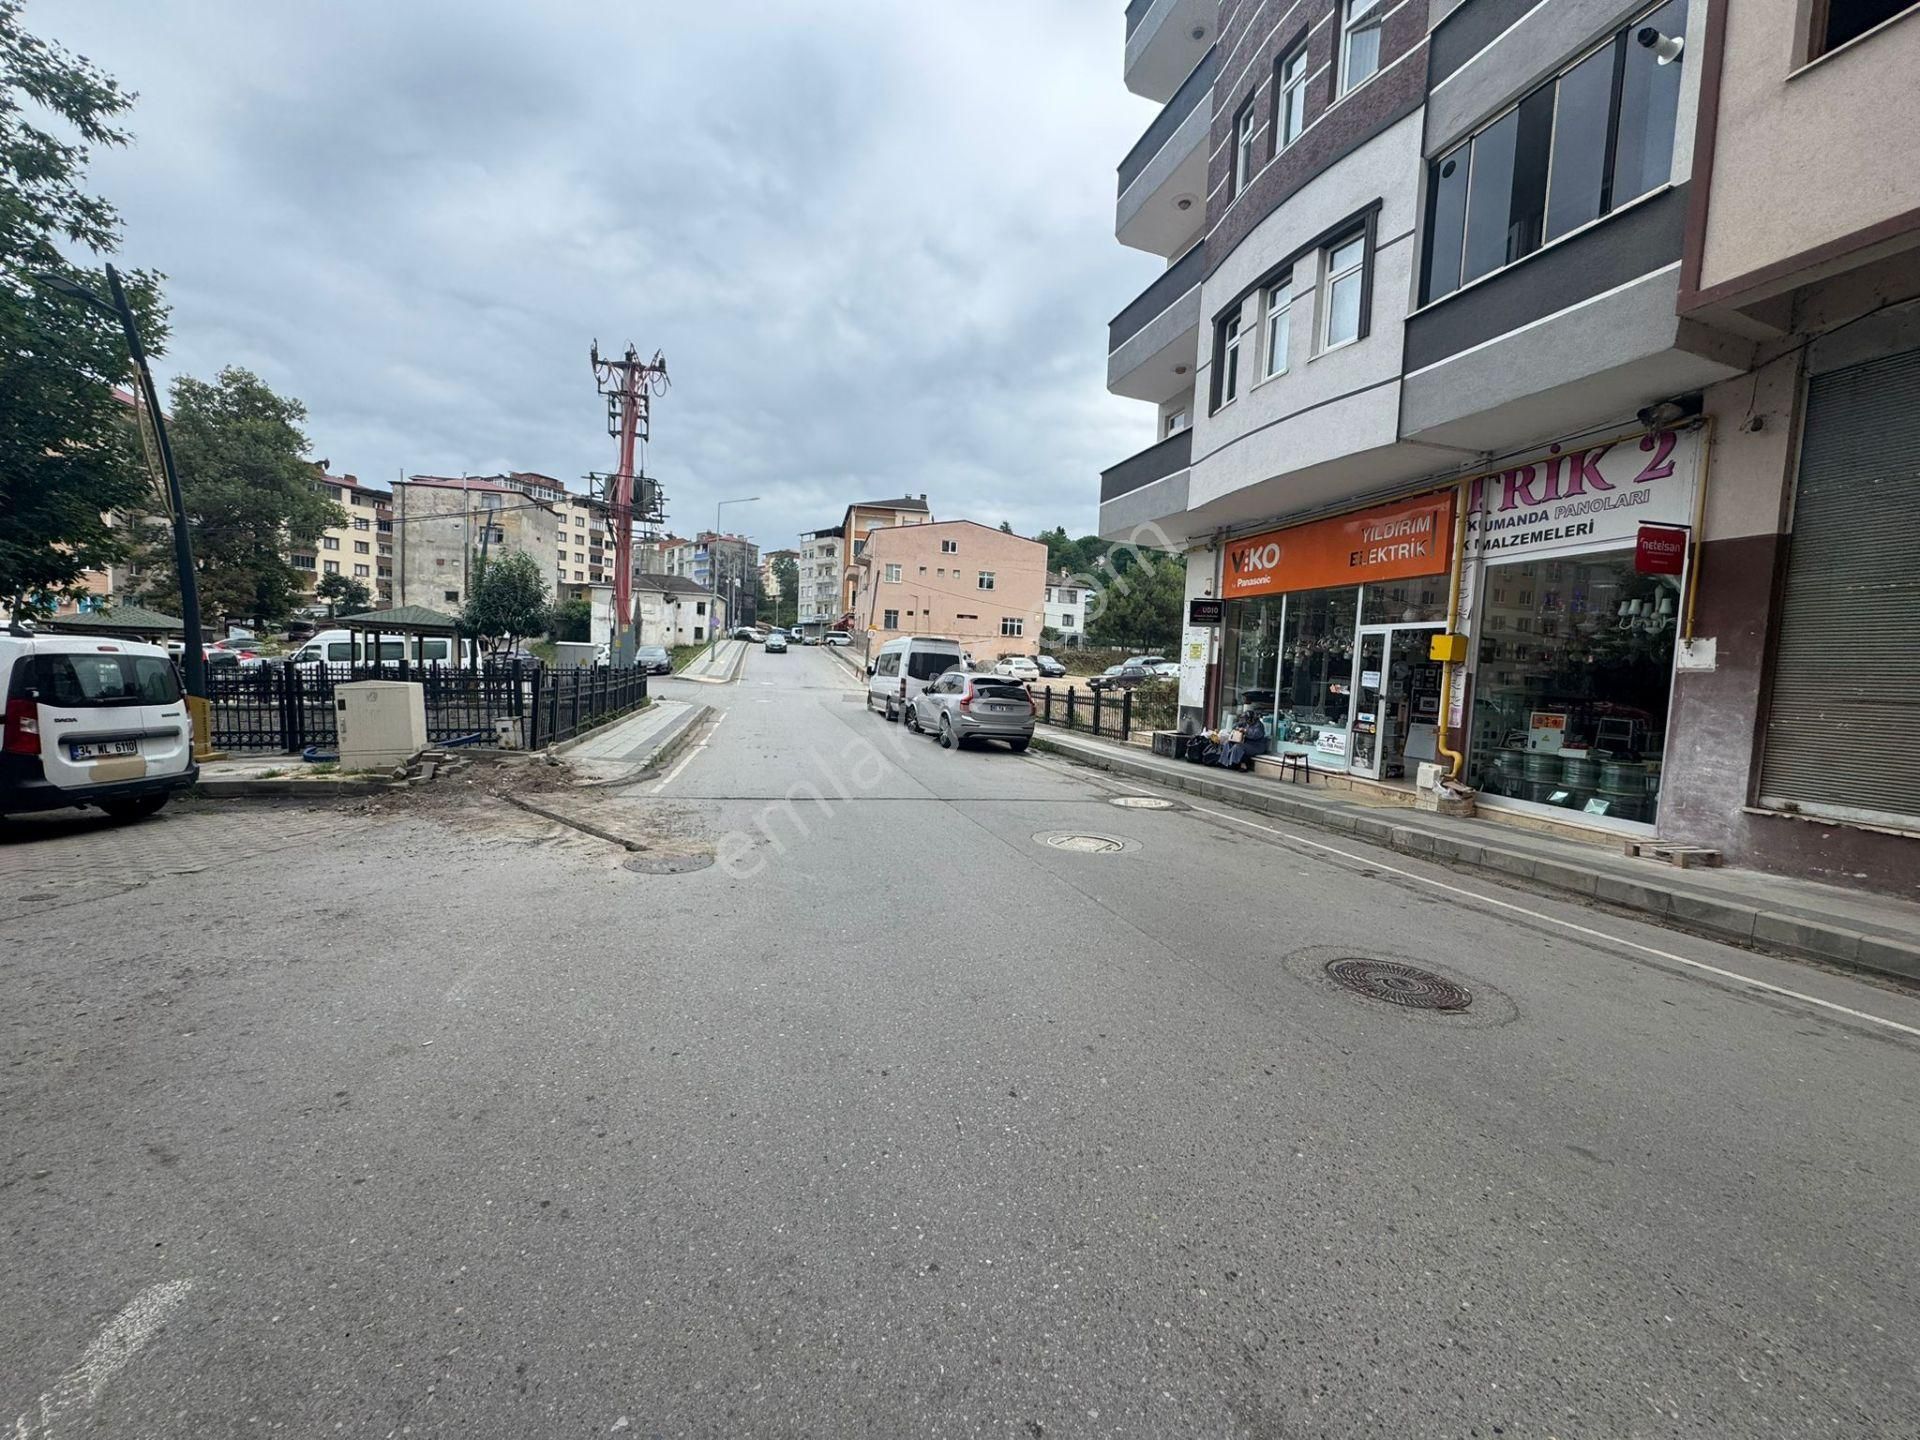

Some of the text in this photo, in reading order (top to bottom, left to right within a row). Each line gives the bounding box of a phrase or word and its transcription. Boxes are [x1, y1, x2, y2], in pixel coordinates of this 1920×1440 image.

[1633, 428, 1677, 483] 2
[1554, 489, 1651, 520] PANOLARI
[1362, 515, 1430, 543] YILDIRIM
[1237, 574, 1271, 587] Panasonic
[78, 746, 92, 756] 34
